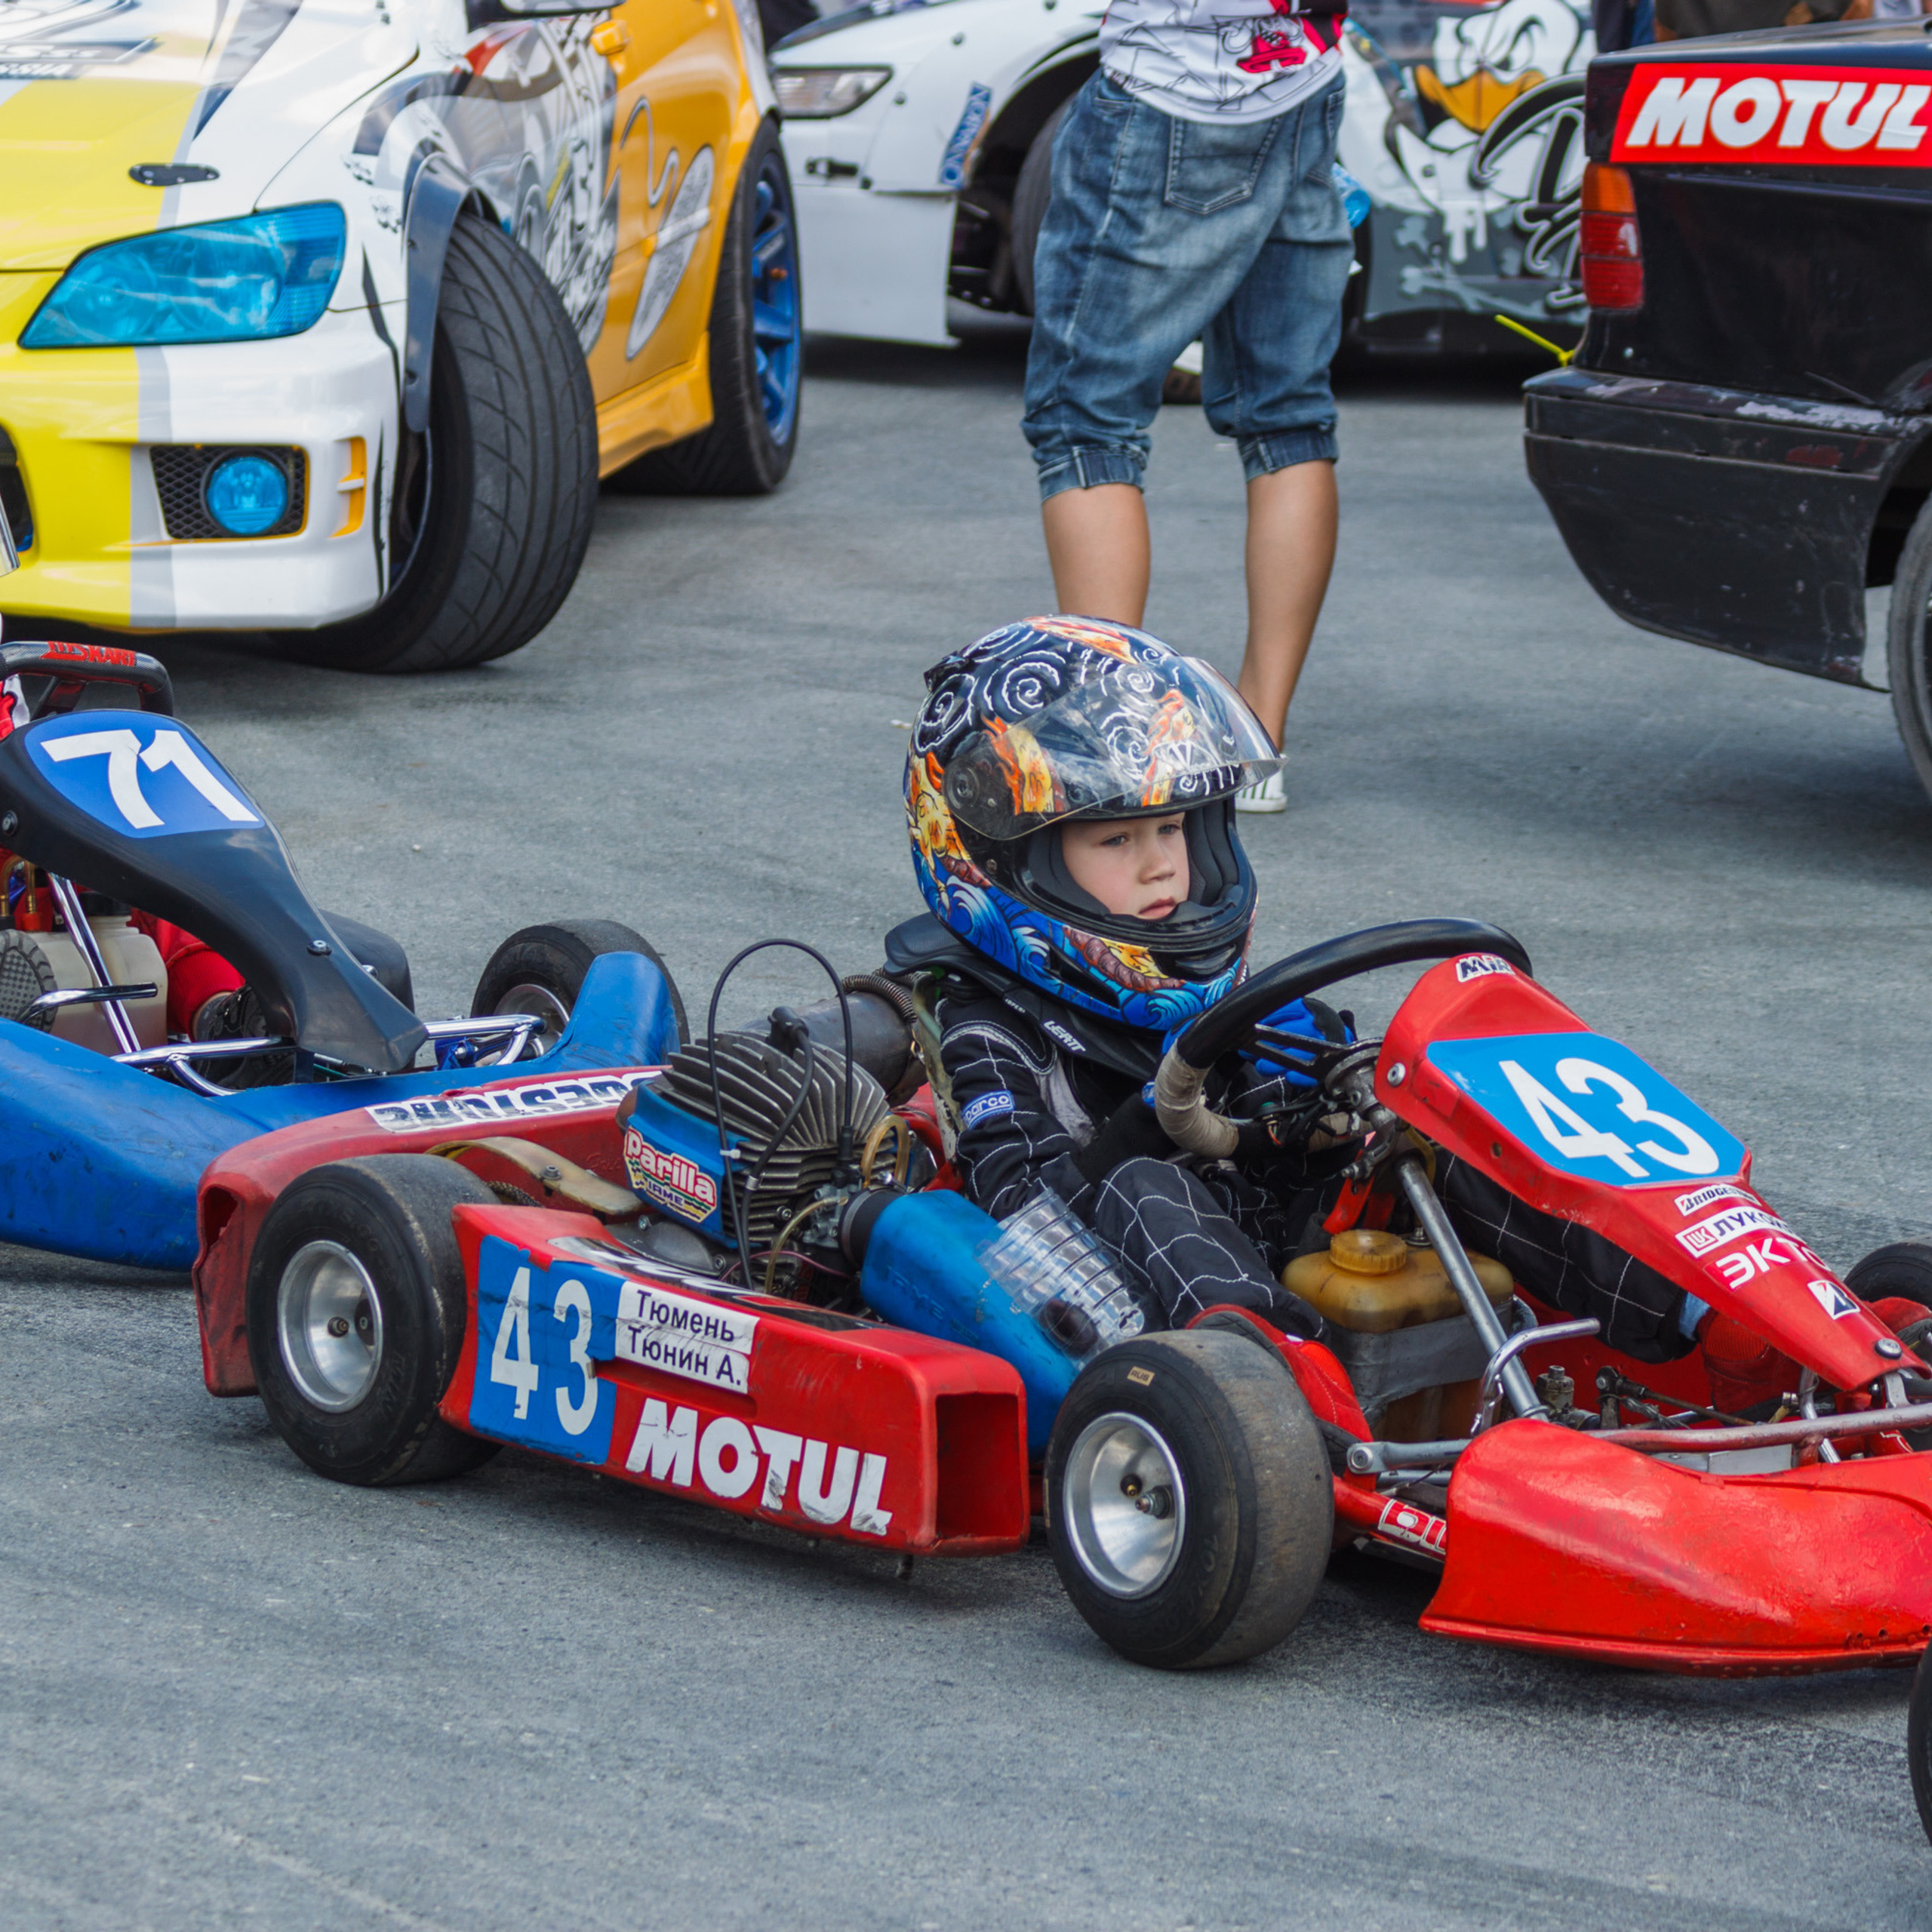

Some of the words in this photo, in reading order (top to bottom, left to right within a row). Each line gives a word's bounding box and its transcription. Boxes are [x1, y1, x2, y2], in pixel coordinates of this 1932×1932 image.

[1626, 77, 1931, 151] MOTUL
[41, 729, 259, 829] 71
[1499, 1057, 1719, 1177] 43
[626, 1128, 715, 1207] Parilla
[491, 1266, 598, 1435] 43
[628, 1324, 709, 1375] Тюнин
[715, 1355, 742, 1386] А.
[636, 1289, 735, 1342] Тюмень
[626, 1398, 892, 1535] MOTUL
